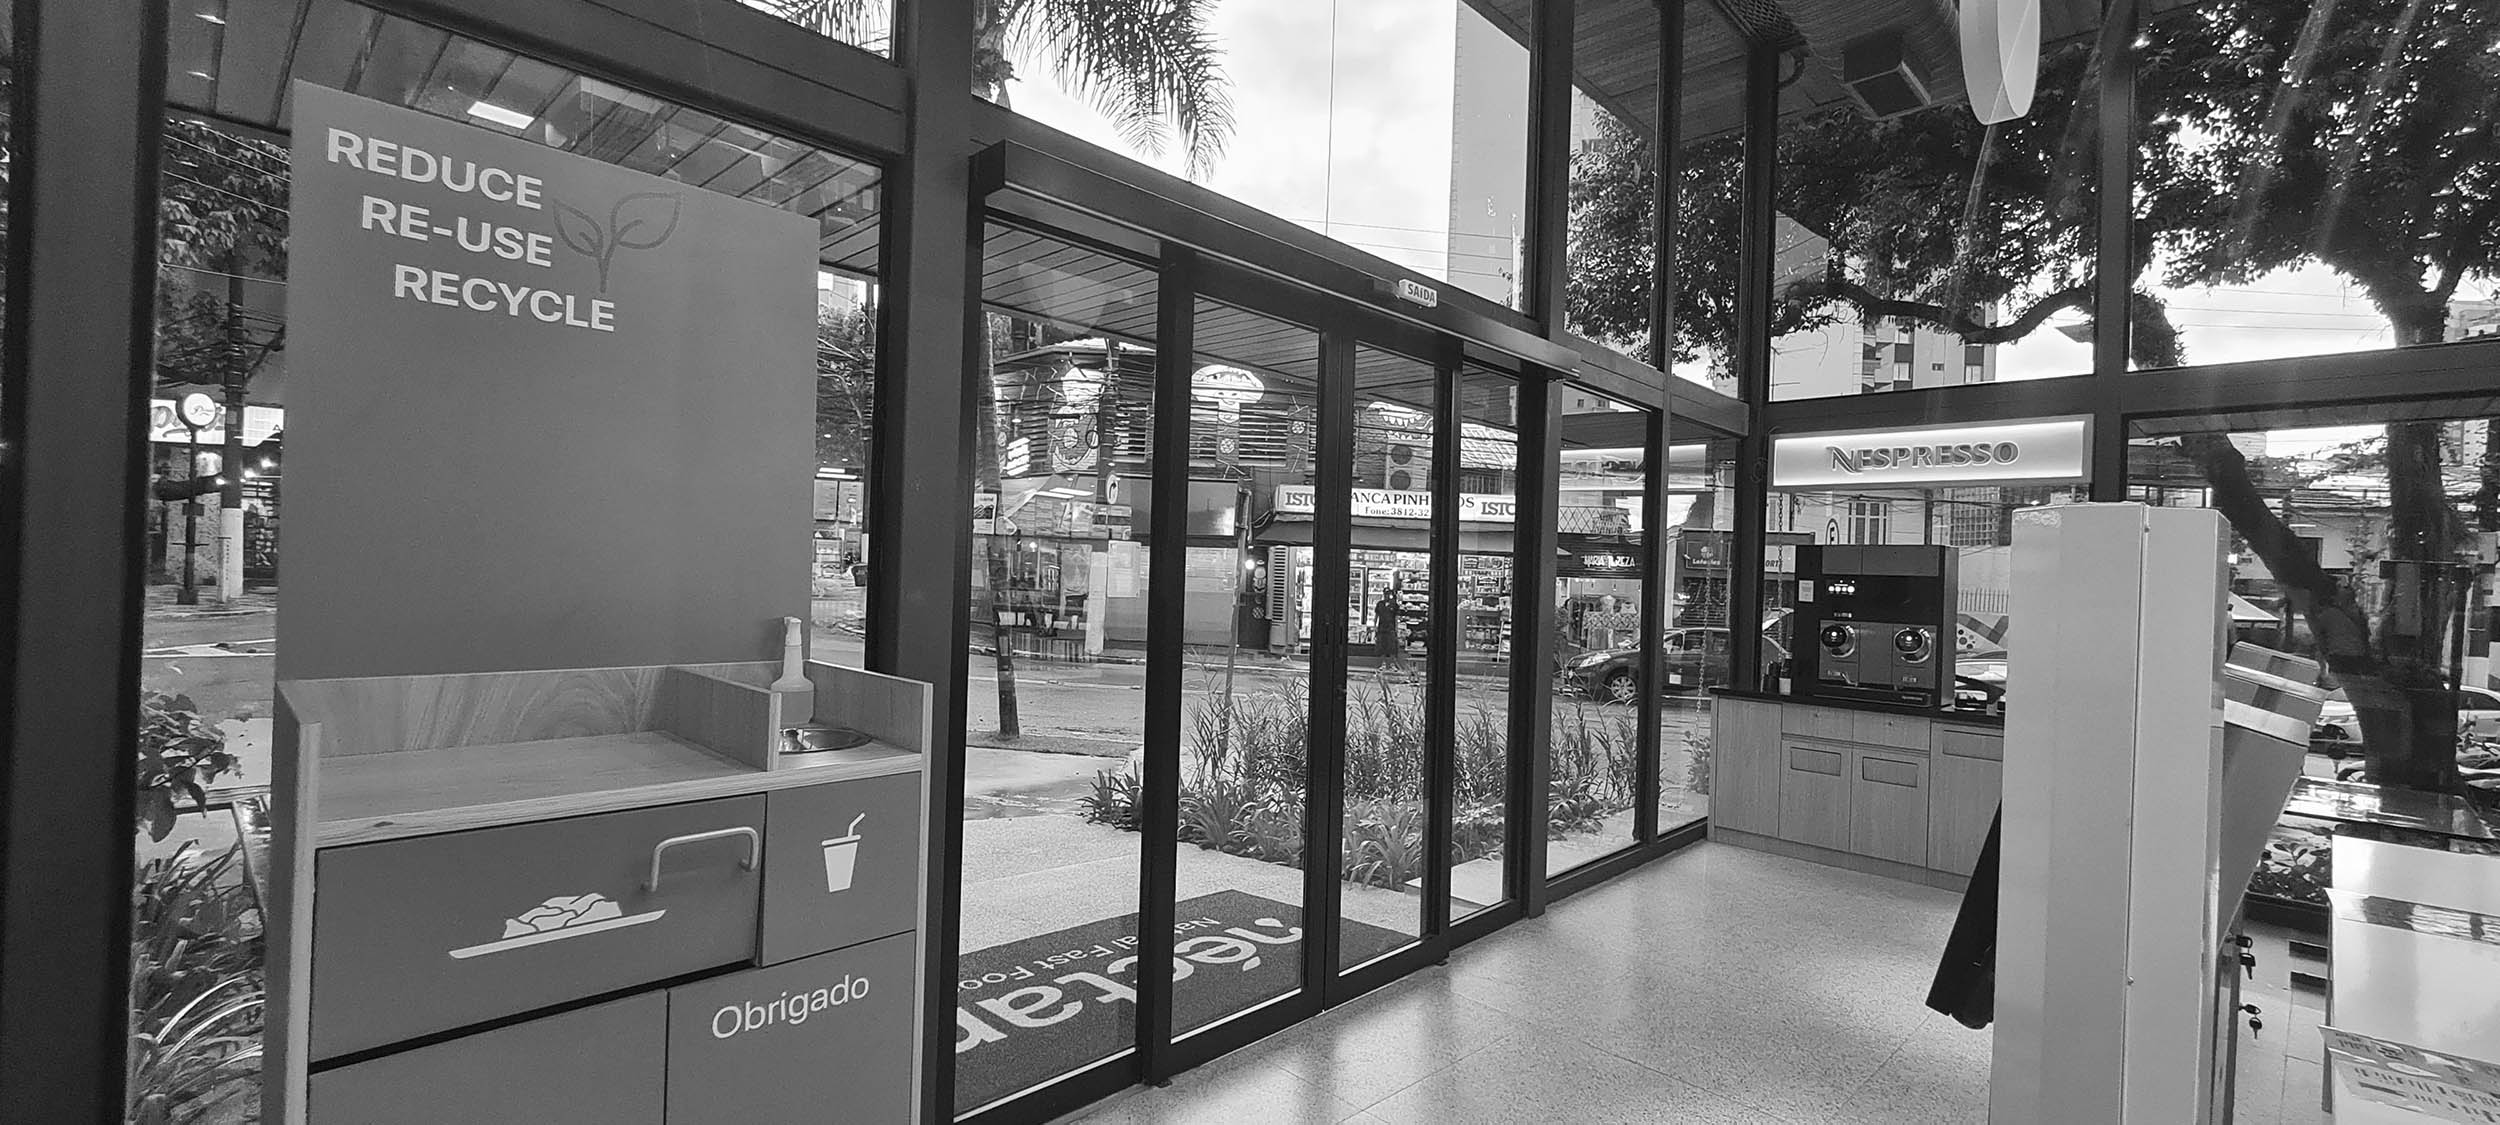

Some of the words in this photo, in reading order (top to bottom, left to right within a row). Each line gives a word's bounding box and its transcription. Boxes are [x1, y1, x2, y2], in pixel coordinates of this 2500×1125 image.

[327, 127, 543, 210] REDUCE
[361, 195, 553, 267] RE-USE
[394, 263, 615, 332] RECYCLE
[1826, 441, 2019, 473] NESPRESSO
[958, 965, 1035, 993] Foo
[1033, 944, 1113, 971] Fast
[712, 974, 869, 1039] Obrigado
